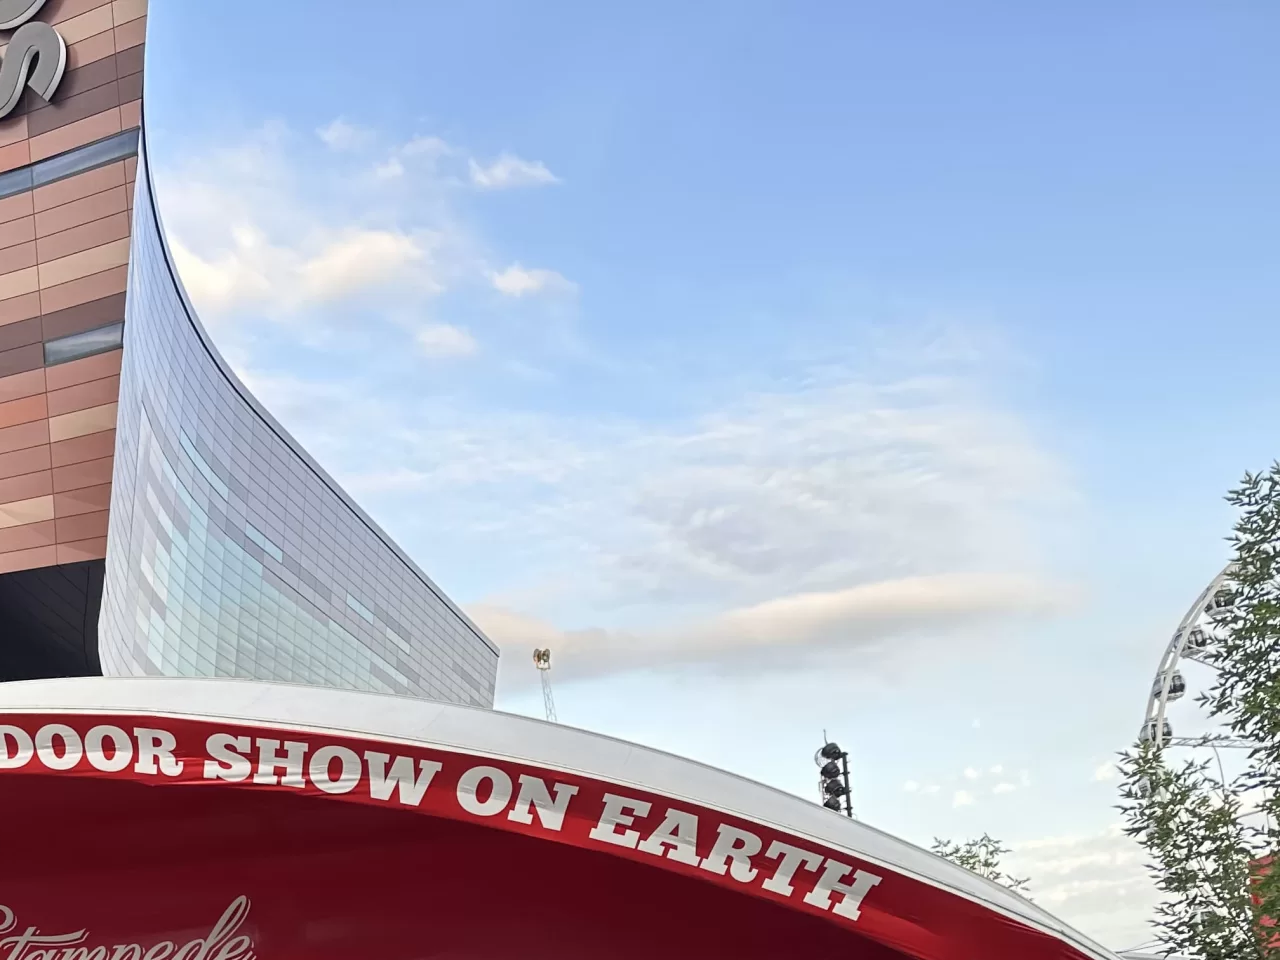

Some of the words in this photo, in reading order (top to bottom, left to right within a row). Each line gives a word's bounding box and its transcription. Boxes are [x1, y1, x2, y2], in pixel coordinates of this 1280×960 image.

[203, 733, 442, 807] SHOW
[456, 765, 579, 832] ON
[589, 792, 883, 922] EARTH
